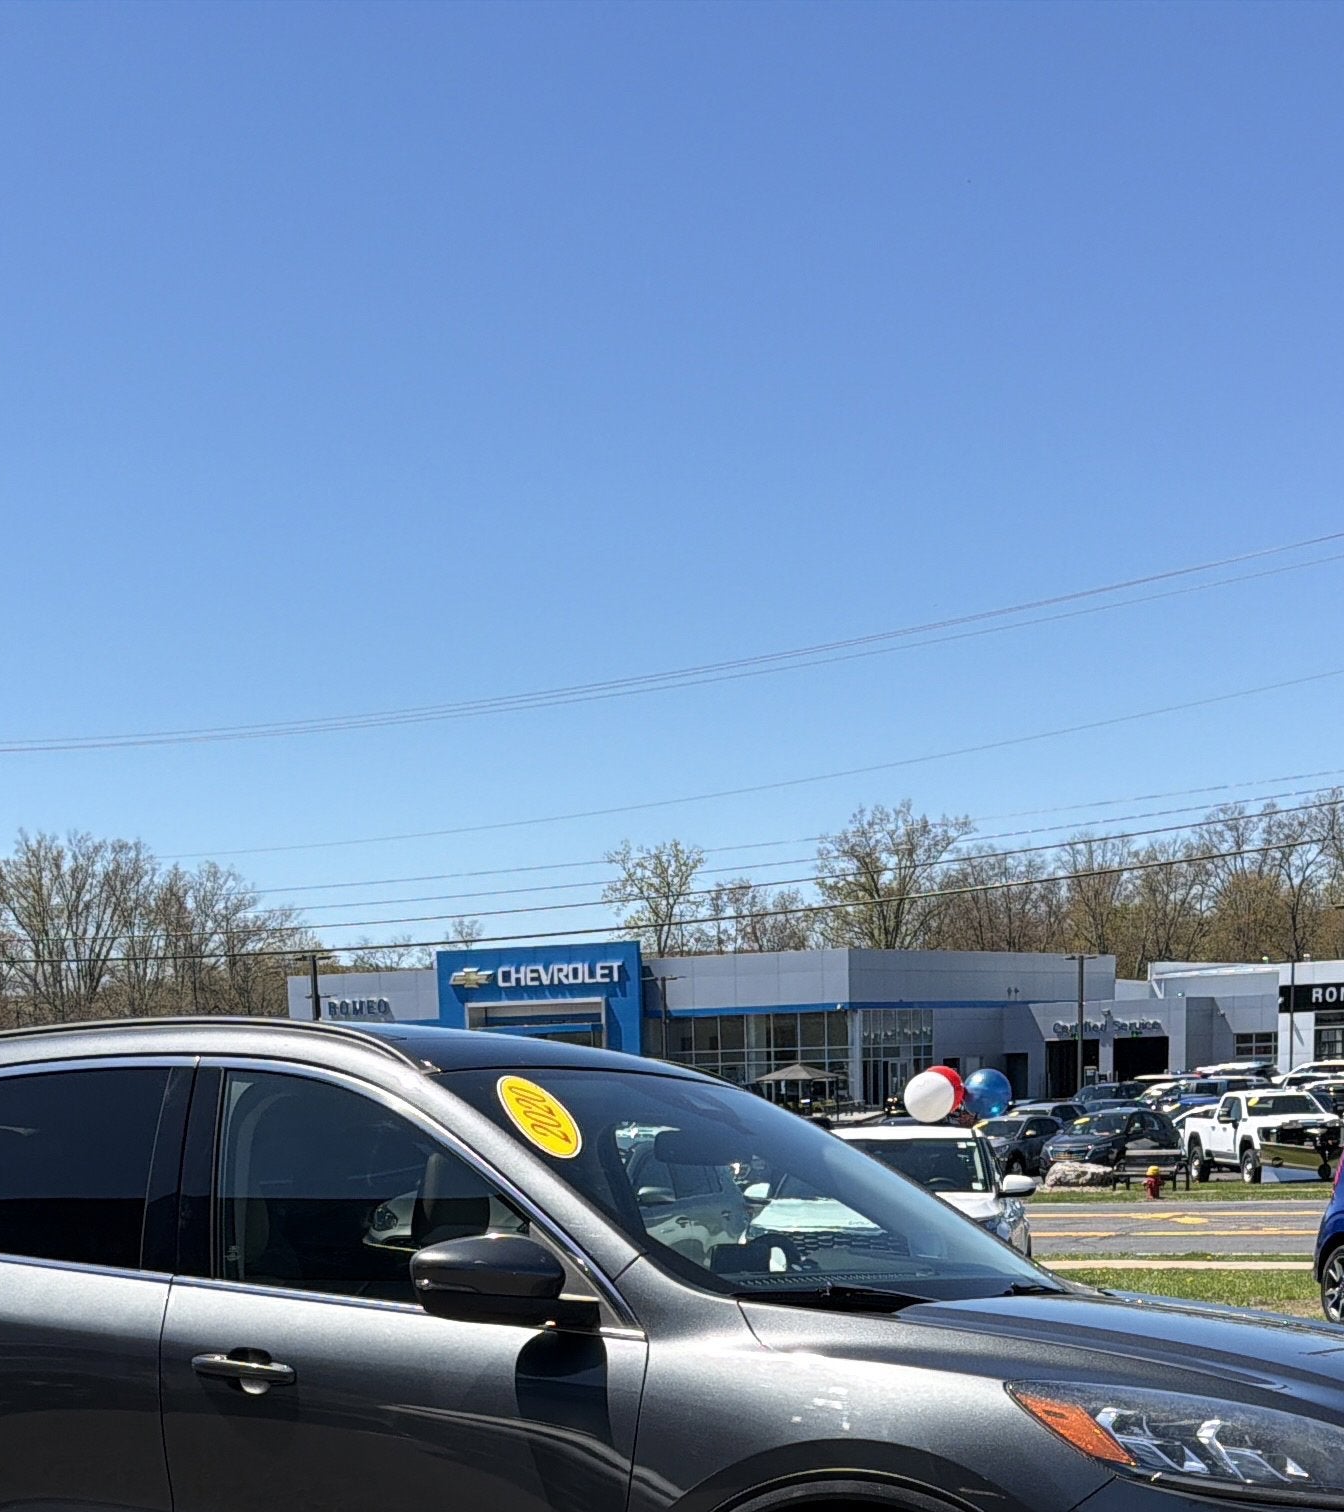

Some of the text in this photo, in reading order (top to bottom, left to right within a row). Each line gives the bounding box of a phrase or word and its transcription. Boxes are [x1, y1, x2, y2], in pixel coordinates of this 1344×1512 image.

[498, 960, 624, 988] CHEVROLET
[328, 999, 387, 1016] ROMEO
[1052, 1020, 1107, 1035] Certfied
[506, 1085, 573, 1145] 2020
